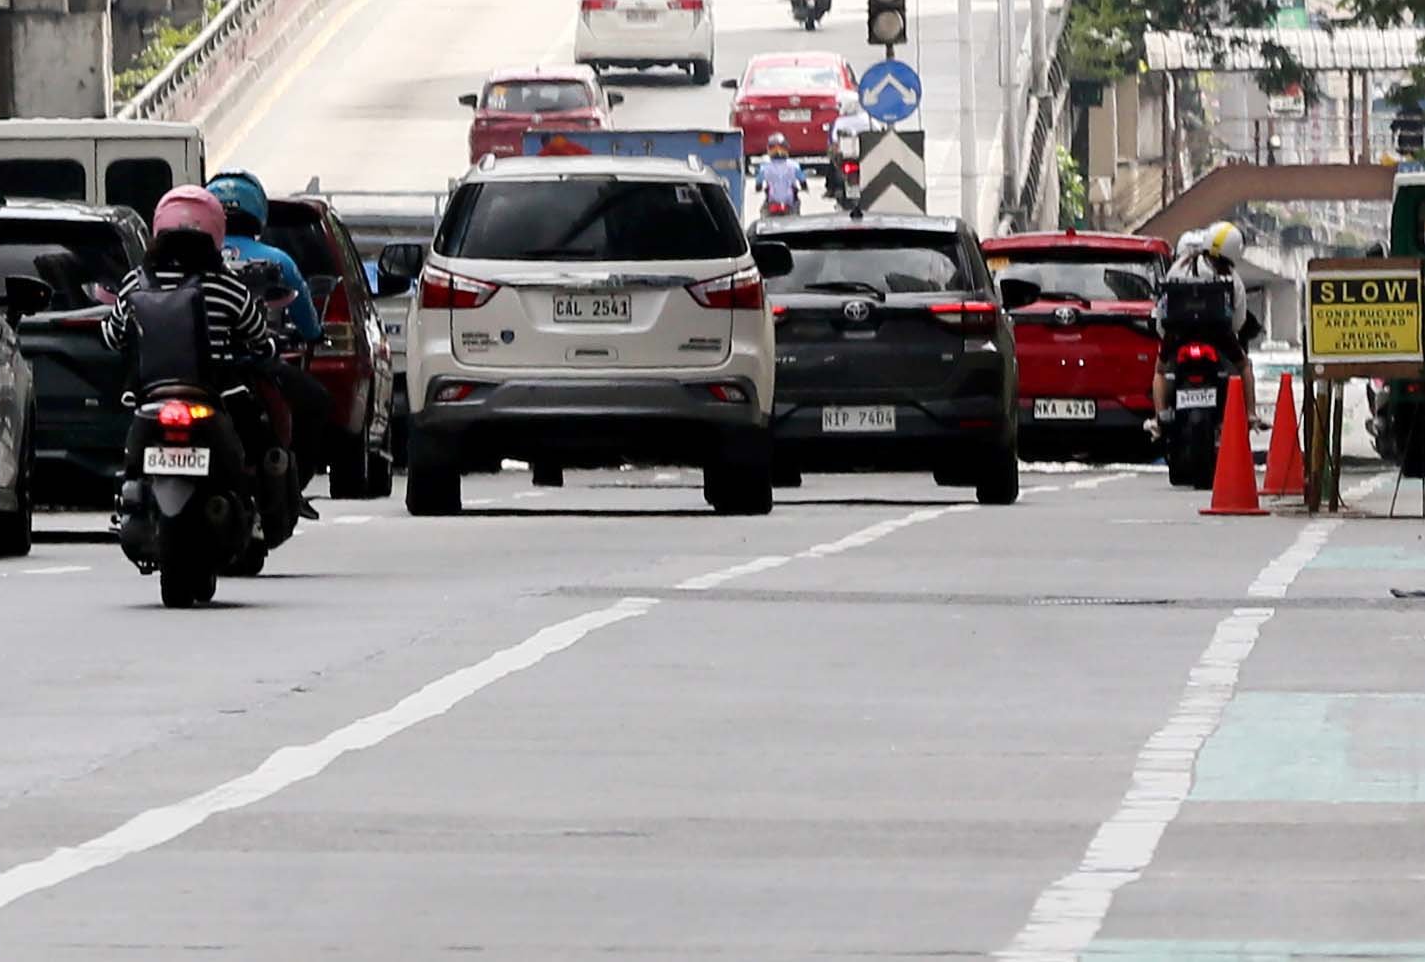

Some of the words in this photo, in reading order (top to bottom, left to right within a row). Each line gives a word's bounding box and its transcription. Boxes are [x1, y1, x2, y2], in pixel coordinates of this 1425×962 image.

[1320, 280, 1408, 303] SLOW
[556, 301, 583, 316] CAL
[592, 301, 628, 316] 2541
[1317, 308, 1414, 319] CONSTRUCTION
[1325, 319, 1358, 327] AREA
[1364, 318, 1406, 327] AHEAD
[1342, 331, 1391, 340] TRUCKS
[1335, 341, 1398, 350] ENTERING
[1035, 401, 1058, 416] NKA
[823, 411, 850, 427] NIP
